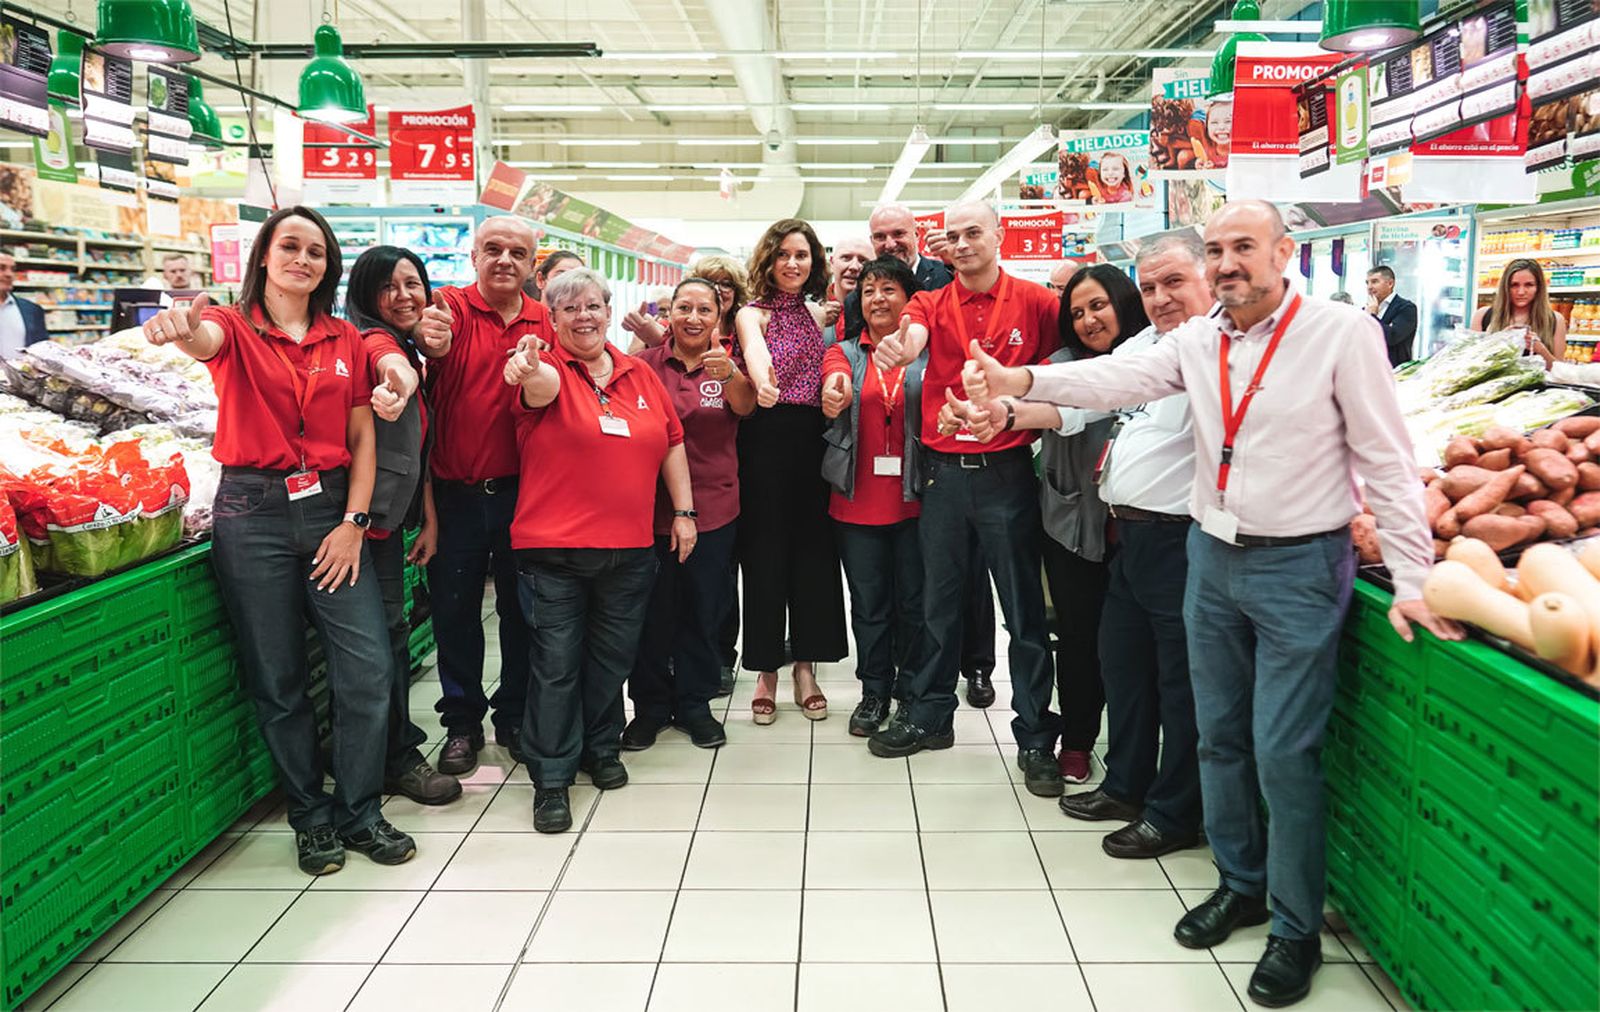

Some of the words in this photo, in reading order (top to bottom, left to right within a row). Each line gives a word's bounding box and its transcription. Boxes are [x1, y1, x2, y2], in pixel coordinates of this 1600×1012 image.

[1253, 65, 1354, 80] PROMOC
[1174, 79, 1211, 98] HEL
[402, 113, 469, 127] PROMOCIÓN
[1074, 133, 1144, 152] HELADOS
[1032, 173, 1057, 185] HEL
[1008, 217, 1056, 228] PROMOCIÓN
